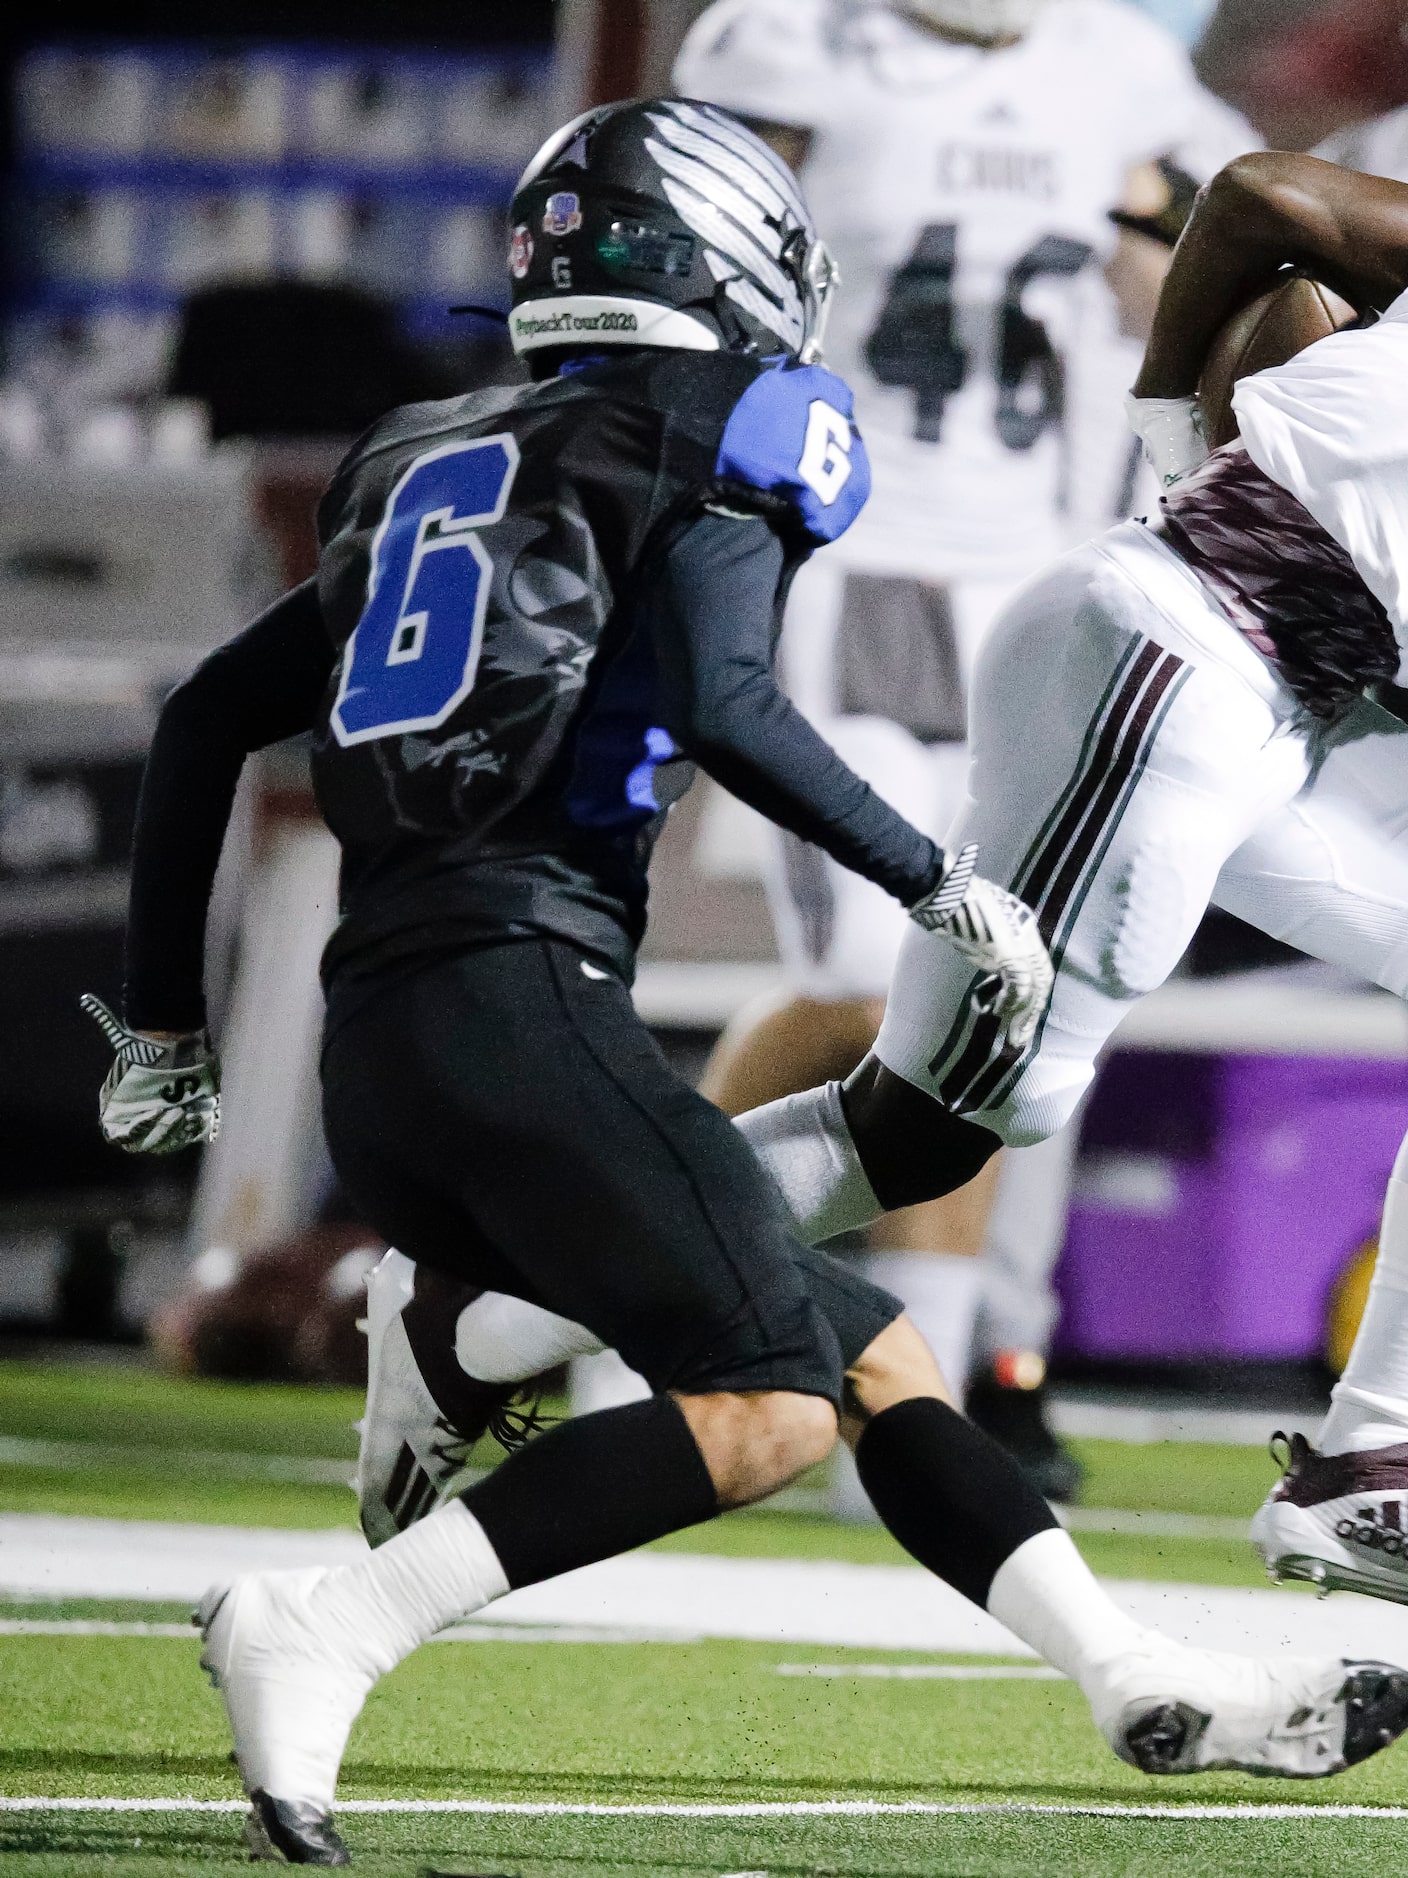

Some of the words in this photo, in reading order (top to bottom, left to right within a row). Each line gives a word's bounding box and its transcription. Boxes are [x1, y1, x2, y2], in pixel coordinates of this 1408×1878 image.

[551, 257, 573, 289] 6
[862, 222, 1093, 452] 46
[798, 399, 853, 507] 6
[330, 432, 521, 748] 6
